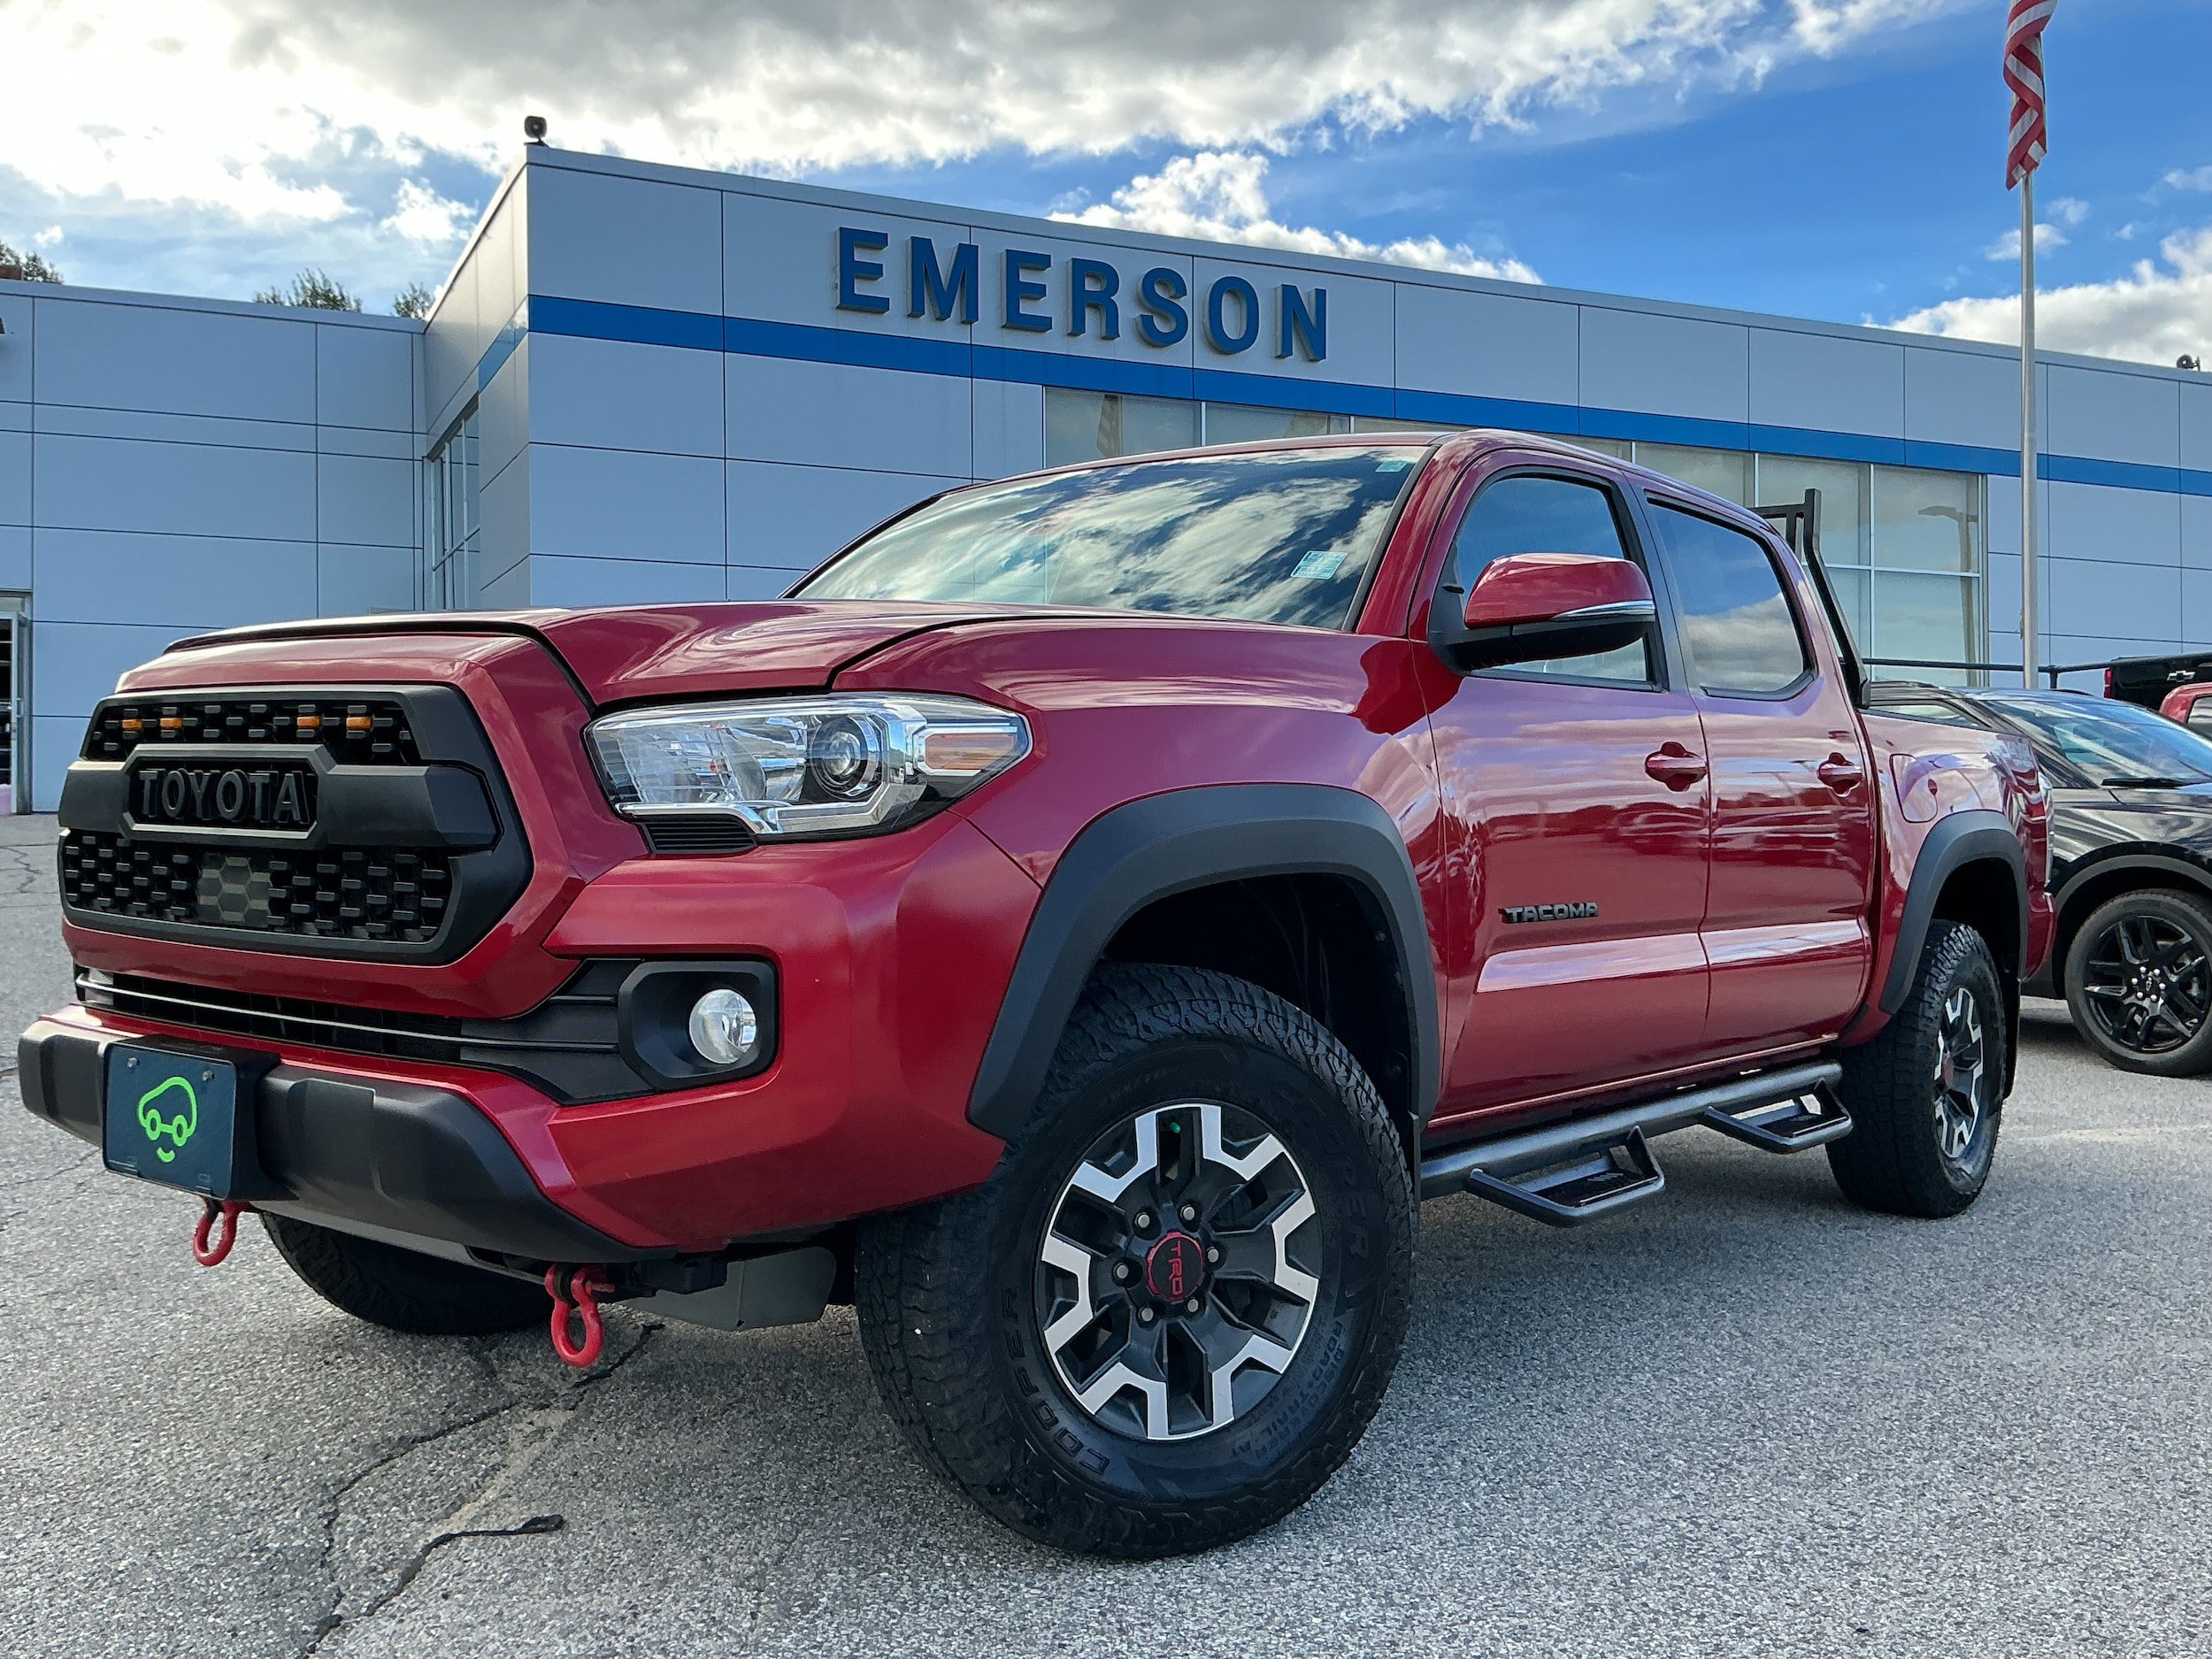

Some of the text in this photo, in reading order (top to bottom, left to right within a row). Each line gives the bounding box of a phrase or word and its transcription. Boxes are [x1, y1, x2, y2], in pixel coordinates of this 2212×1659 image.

[835, 227, 1326, 362] EMERSON
[138, 767, 310, 824] TOYOTA
[1504, 901, 1599, 924] TACOMA
[1168, 1239, 1183, 1295] TRD
[1002, 1287, 1110, 1475] COOPER
